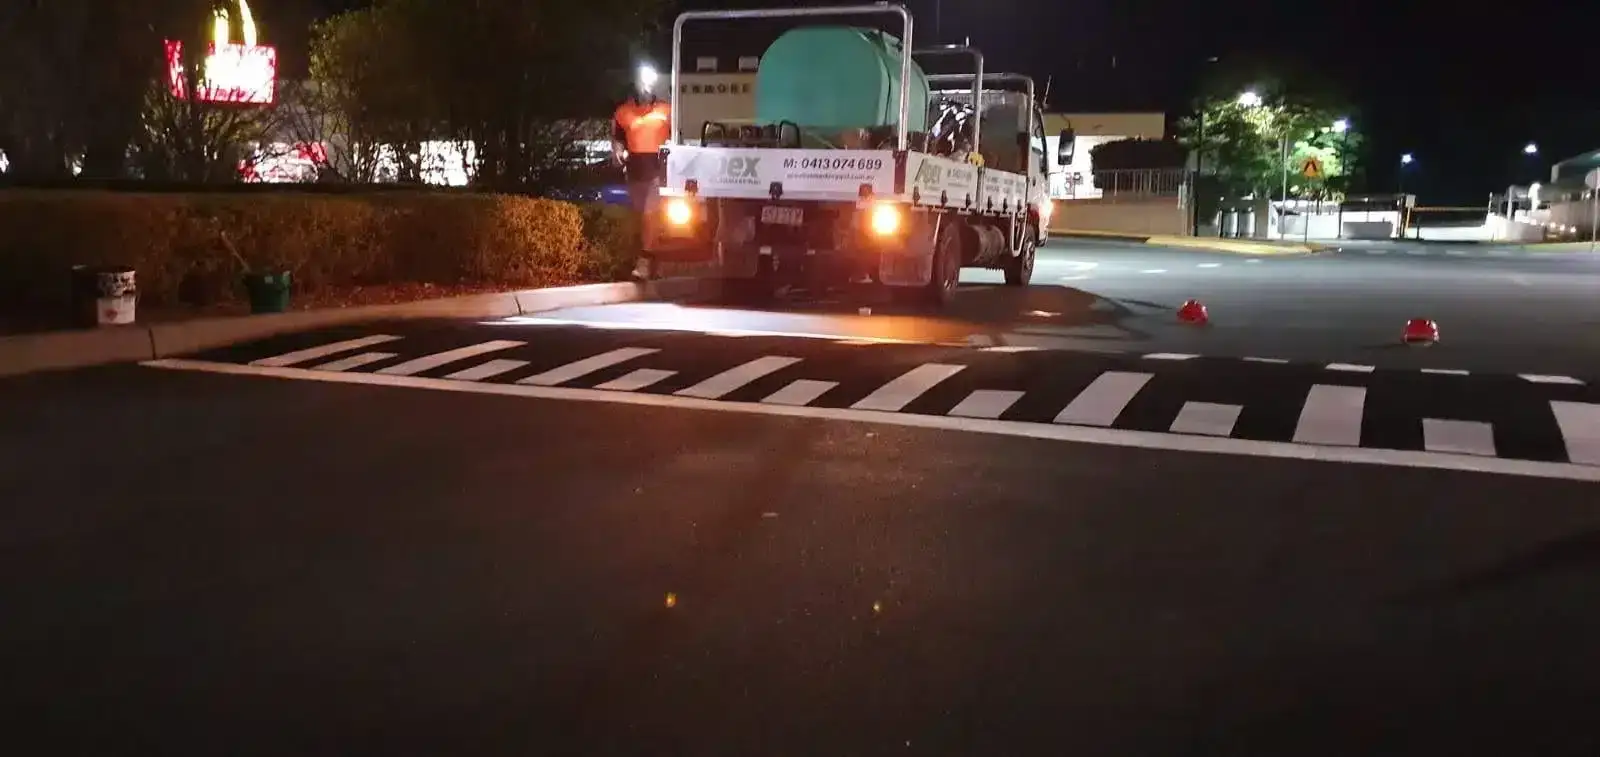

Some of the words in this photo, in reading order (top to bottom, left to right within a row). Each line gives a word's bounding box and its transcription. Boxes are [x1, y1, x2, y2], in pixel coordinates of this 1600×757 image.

[801, 158, 831, 170] 0413
[832, 158, 856, 170] 074
[857, 158, 883, 170] 689
